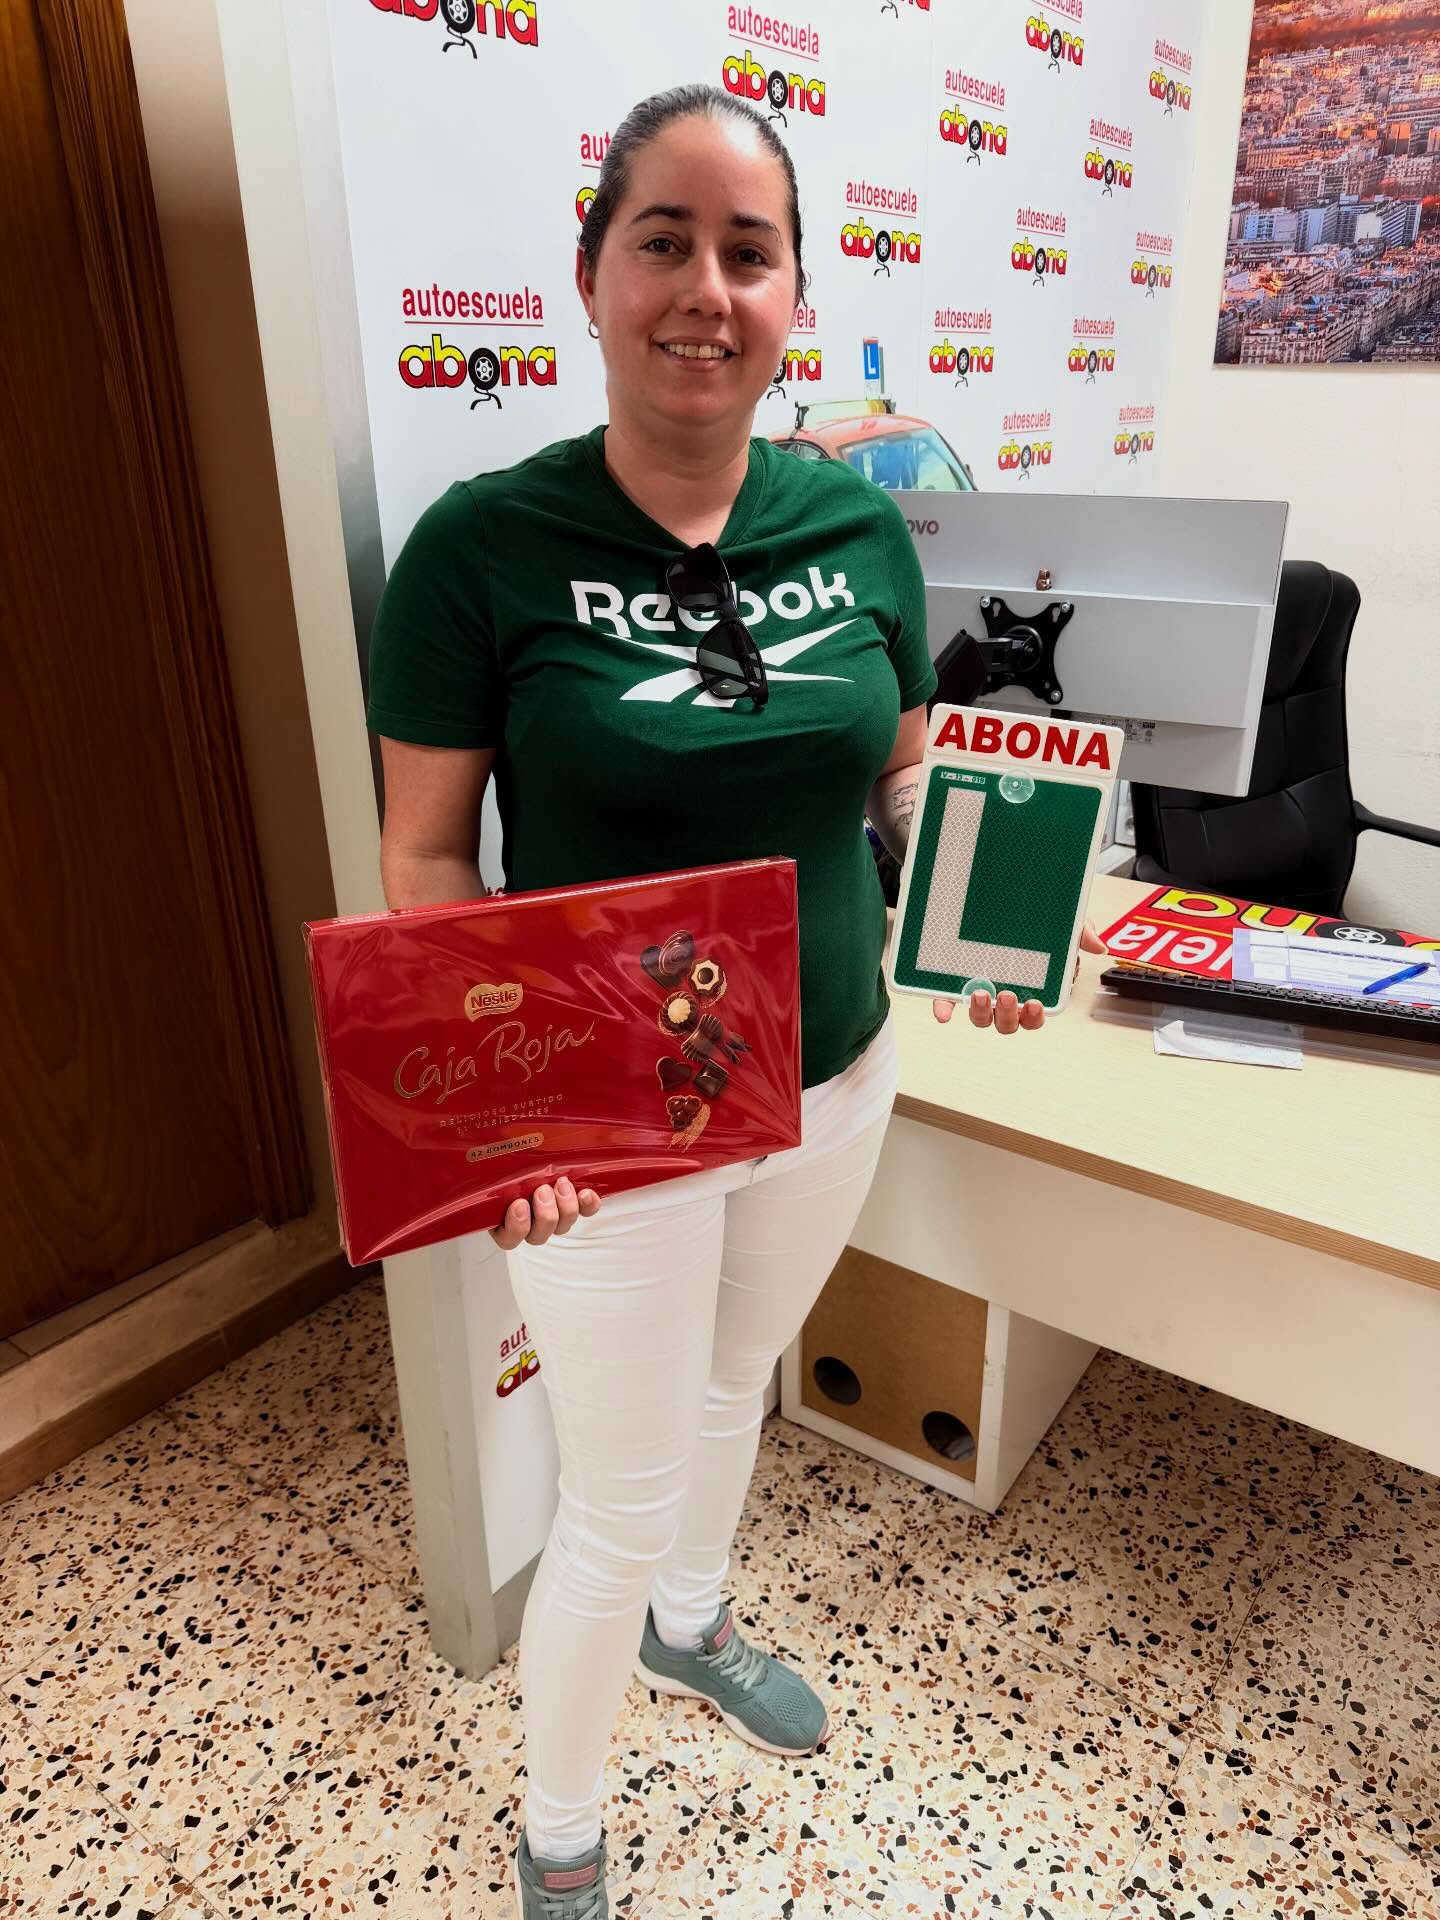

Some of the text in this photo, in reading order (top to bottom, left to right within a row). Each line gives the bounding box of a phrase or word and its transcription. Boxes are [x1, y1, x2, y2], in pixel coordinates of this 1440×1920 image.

[728, 4, 820, 56] autoescuela
[1026, 12, 1084, 66] abona
[1154, 38, 1193, 71] autoescuela
[722, 50, 826, 117] abona
[945, 67, 1006, 107] autoescuela
[1149, 67, 1192, 112] abona
[939, 105, 1008, 156] abona
[1090, 117, 1133, 148] autoescuela
[1084, 147, 1133, 189] abona
[846, 181, 918, 213] autoescuela
[1017, 205, 1067, 233] autoescuela
[840, 217, 922, 264] abona
[1011, 237, 1068, 277] abona
[1136, 229, 1173, 252] autoescuela
[1131, 256, 1173, 288] abona
[402, 284, 544, 320] autoescuela
[934, 307, 992, 330] autoescuela
[1073, 315, 1115, 336] autoescuela
[399, 334, 557, 390] abona
[929, 339, 994, 376] abona
[1068, 343, 1116, 373] abona
[1003, 408, 1051, 431] autoescuela
[1119, 404, 1154, 422] autoescuela
[998, 439, 1053, 470] abona
[1114, 430, 1154, 456] abona
[933, 712, 1112, 770] ABONA
[915, 786, 1050, 990] L
[470, 988, 518, 1010] Nestlé
[393, 1046, 478, 1105] Caja
[440, 1093, 563, 1128] DELICIOSO SURTIDO
[475, 1106, 549, 1129] VARIEDADES
[487, 1136, 540, 1155] BOMBONES
